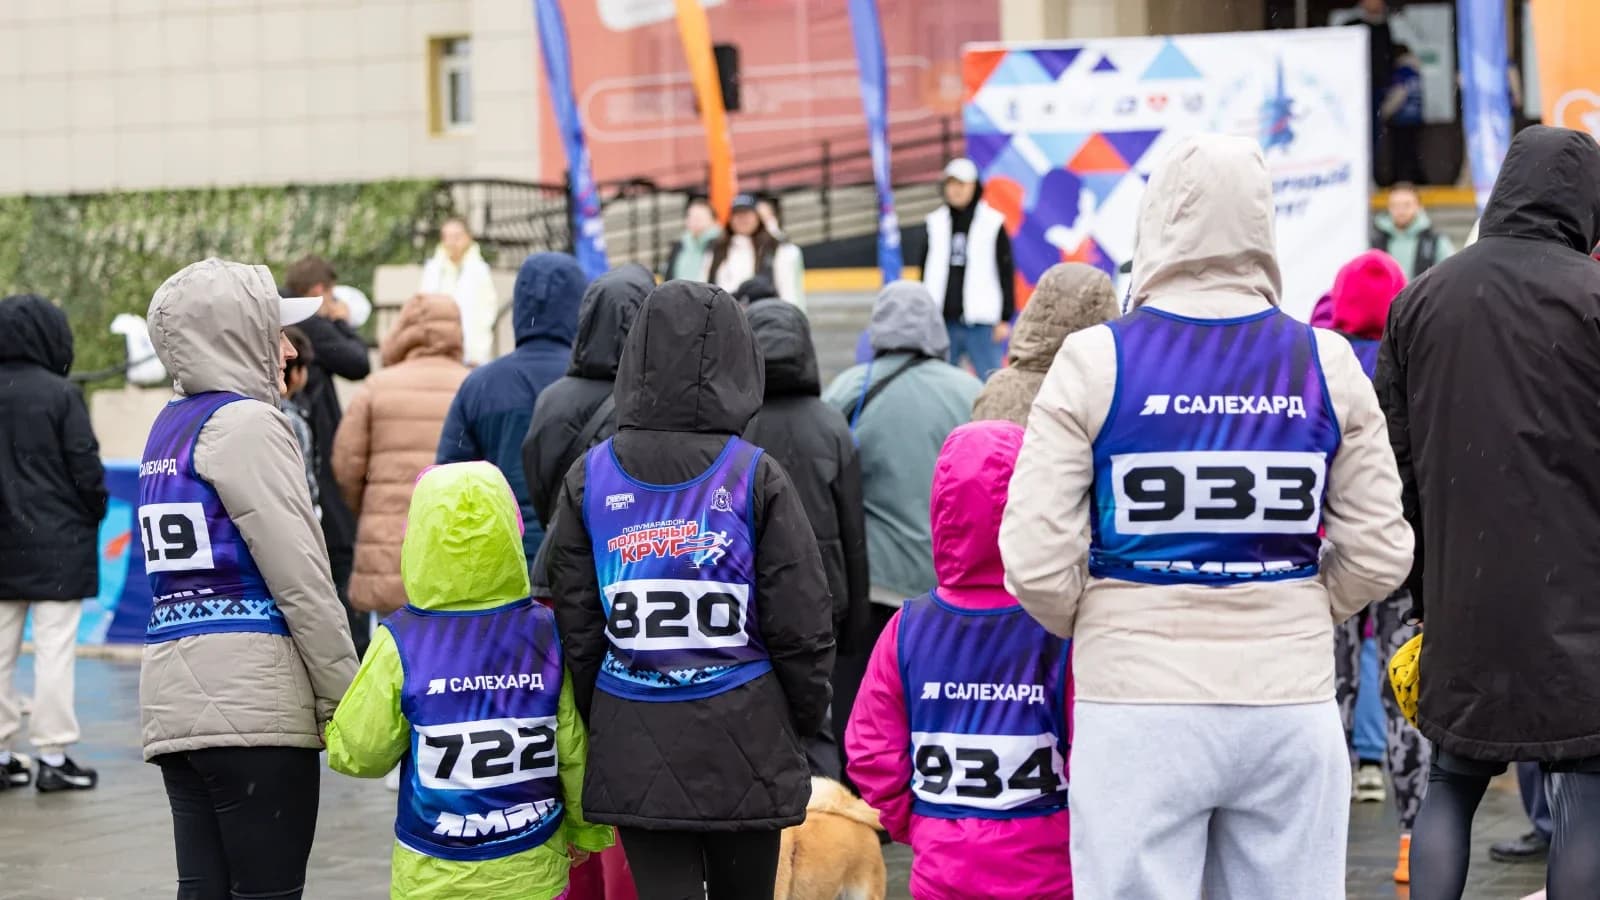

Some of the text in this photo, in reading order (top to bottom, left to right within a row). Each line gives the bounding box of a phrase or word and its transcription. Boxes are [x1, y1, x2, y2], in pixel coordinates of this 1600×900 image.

[1174, 394, 1307, 419] САЛЕХАРД
[1124, 465, 1317, 522] 933
[143, 513, 198, 561] 19
[607, 521, 699, 553] ПОЛЯРНЫЙ
[622, 518, 685, 534] ПОЛУМАРАФОН
[620, 537, 686, 566] КРУГ
[607, 590, 742, 639] 820
[449, 673, 545, 693] САЛЕХАРД
[944, 682, 1045, 705] САЛЕХАРД
[425, 724, 556, 780] 722
[916, 744, 1062, 799] 934
